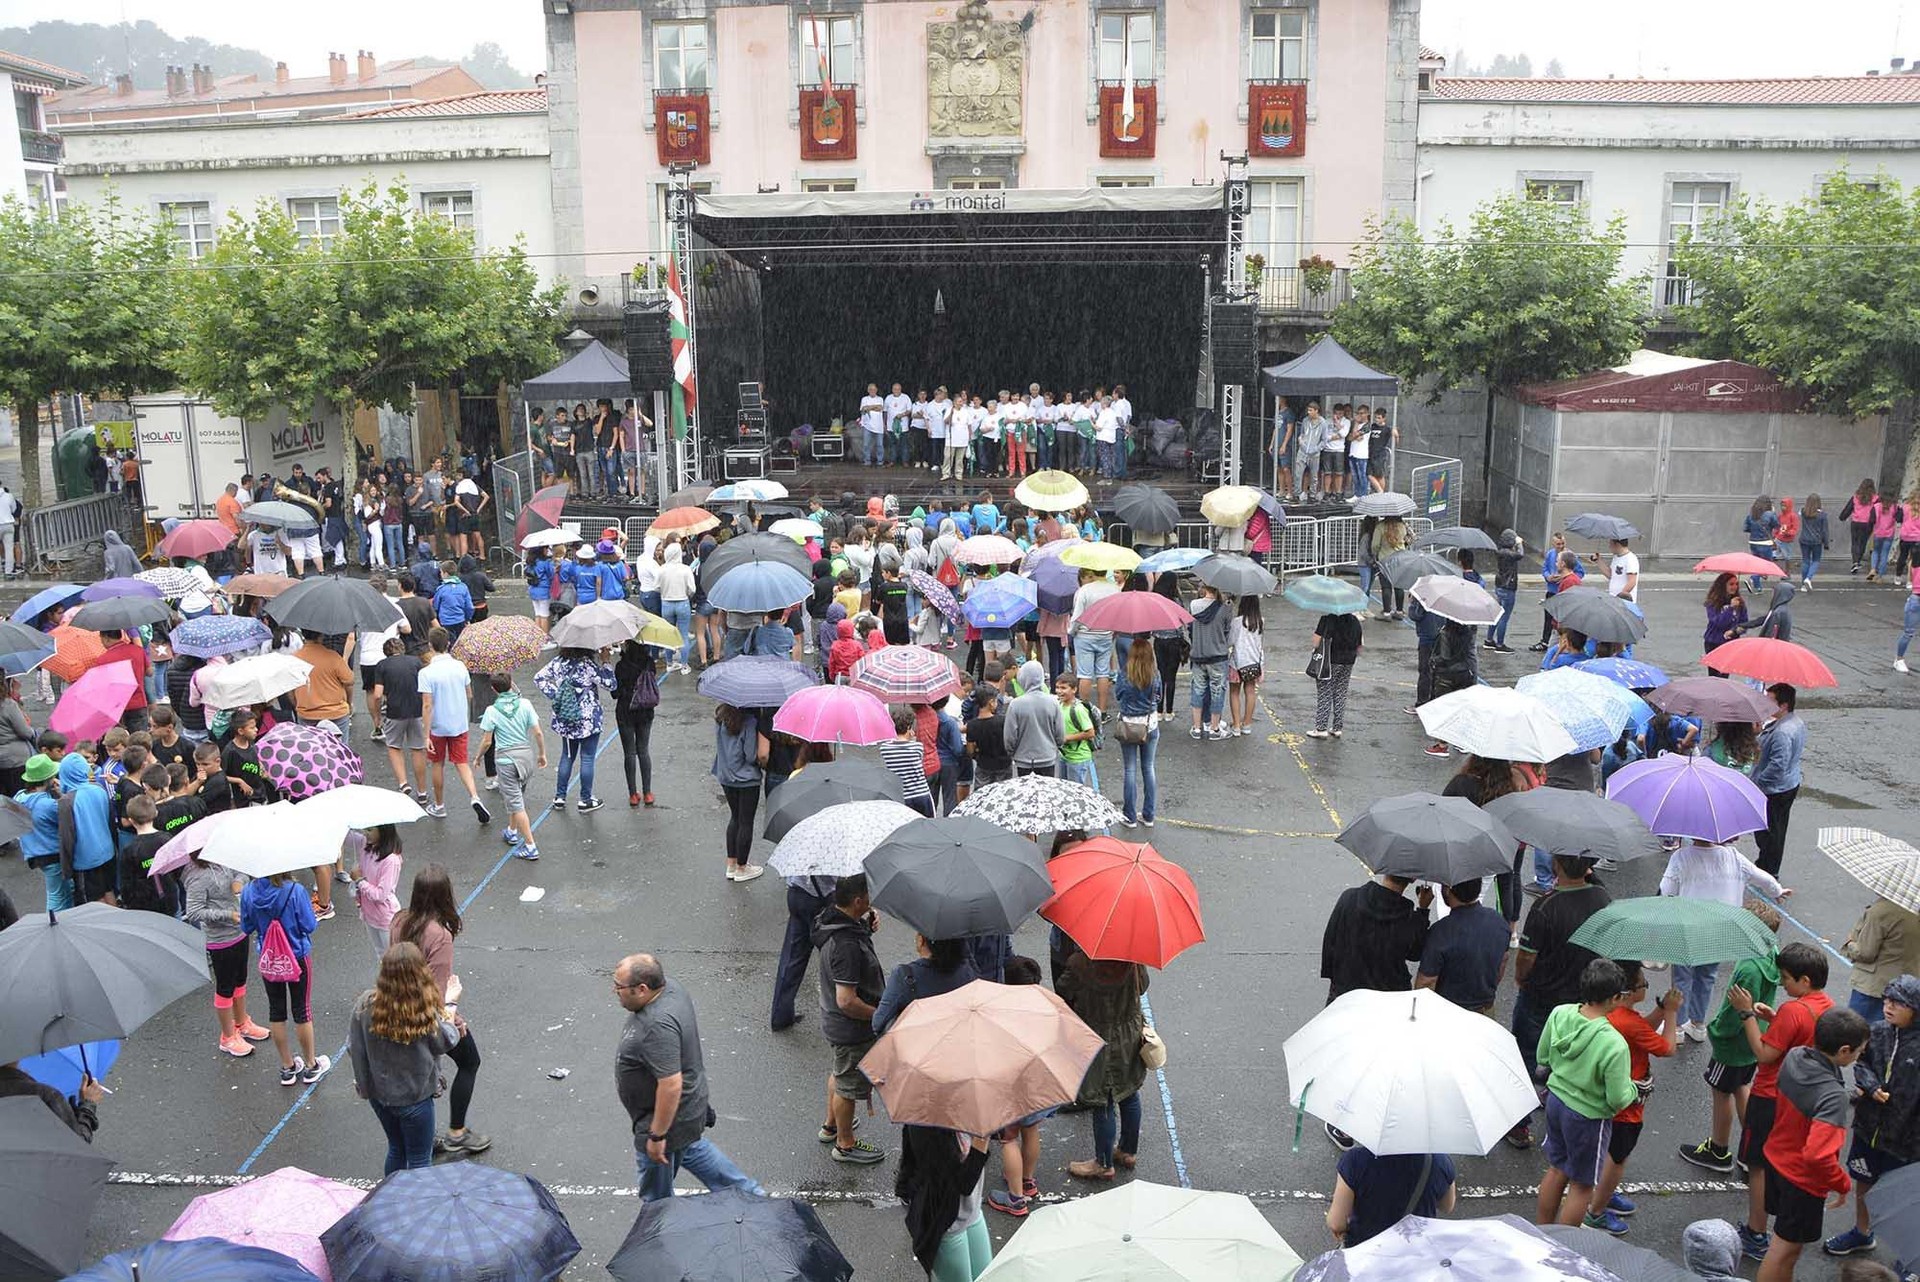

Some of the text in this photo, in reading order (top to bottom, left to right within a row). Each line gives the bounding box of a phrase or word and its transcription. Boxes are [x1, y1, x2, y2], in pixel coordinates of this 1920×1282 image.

[945, 191, 1006, 210] montai
[141, 431, 182, 442] MOLATU
[270, 421, 325, 452] MOLATU
